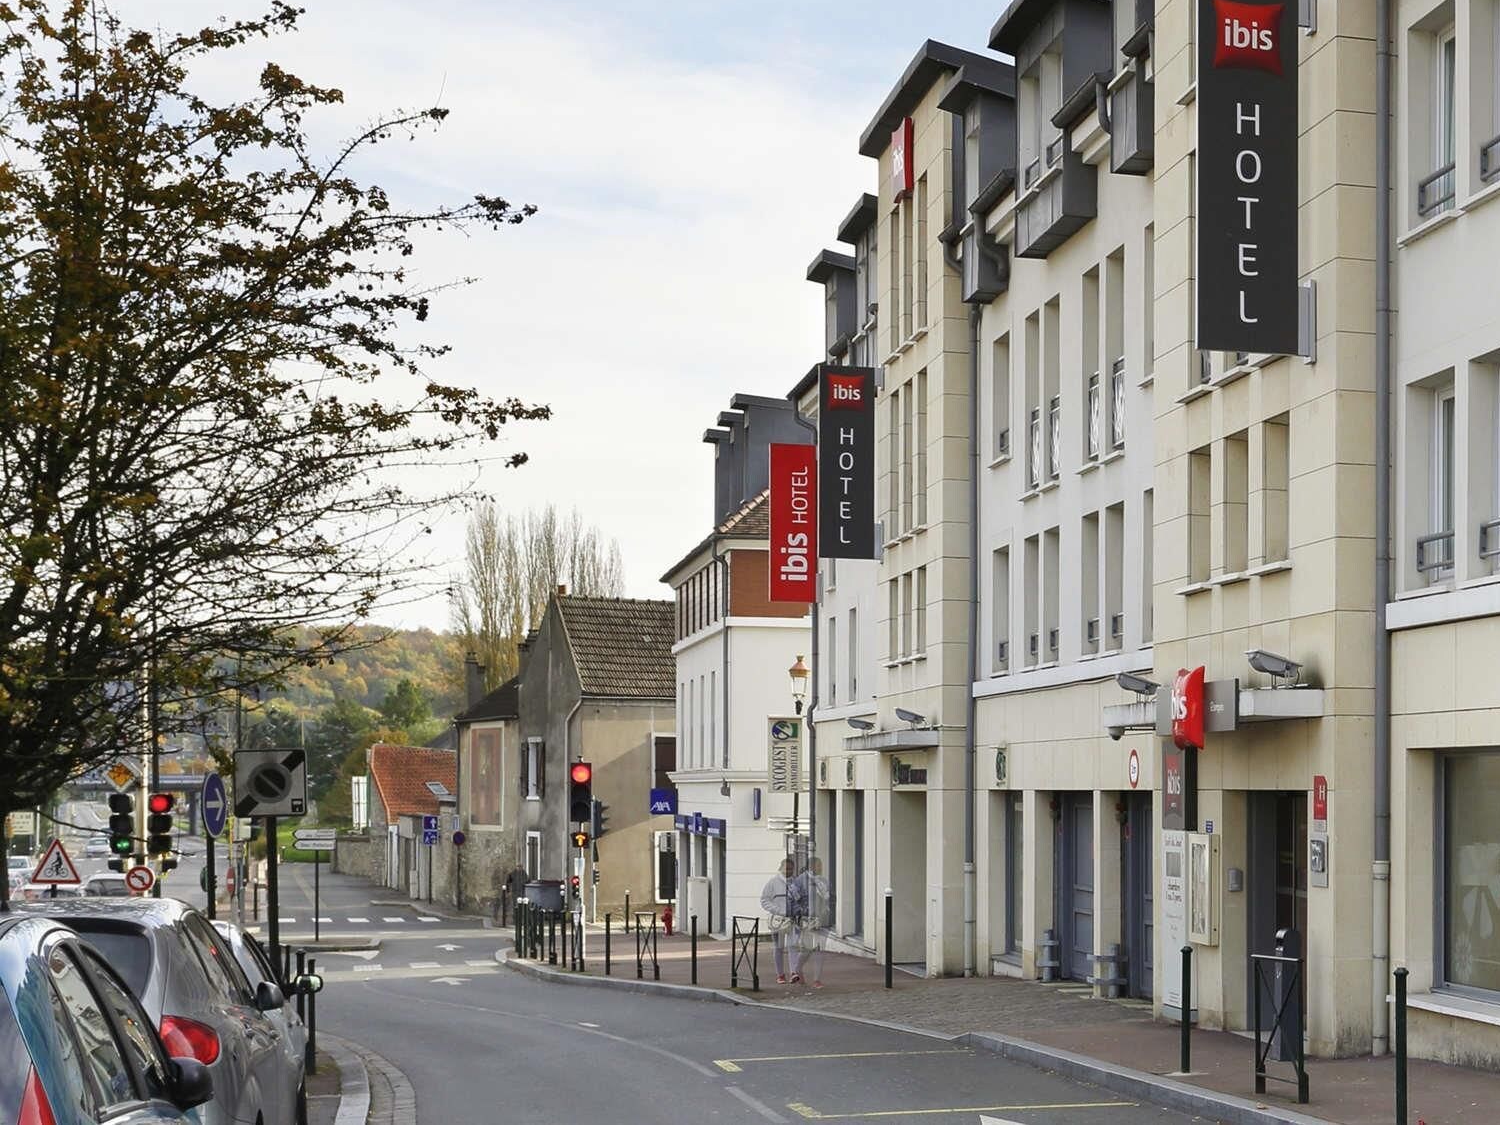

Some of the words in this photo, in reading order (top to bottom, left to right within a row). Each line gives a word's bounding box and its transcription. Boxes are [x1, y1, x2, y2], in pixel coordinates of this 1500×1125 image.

[1224, 18, 1273, 51] ibis
[1235, 103, 1262, 324] HOTEL
[833, 384, 861, 400] ibis
[792, 466, 808, 524] HOTEL
[839, 428, 854, 544] HOTEL
[780, 533, 808, 582] ibis
[1171, 686, 1187, 720] bis
[772, 746, 787, 791] SYCOGEST
[650, 801, 671, 812] AXA
